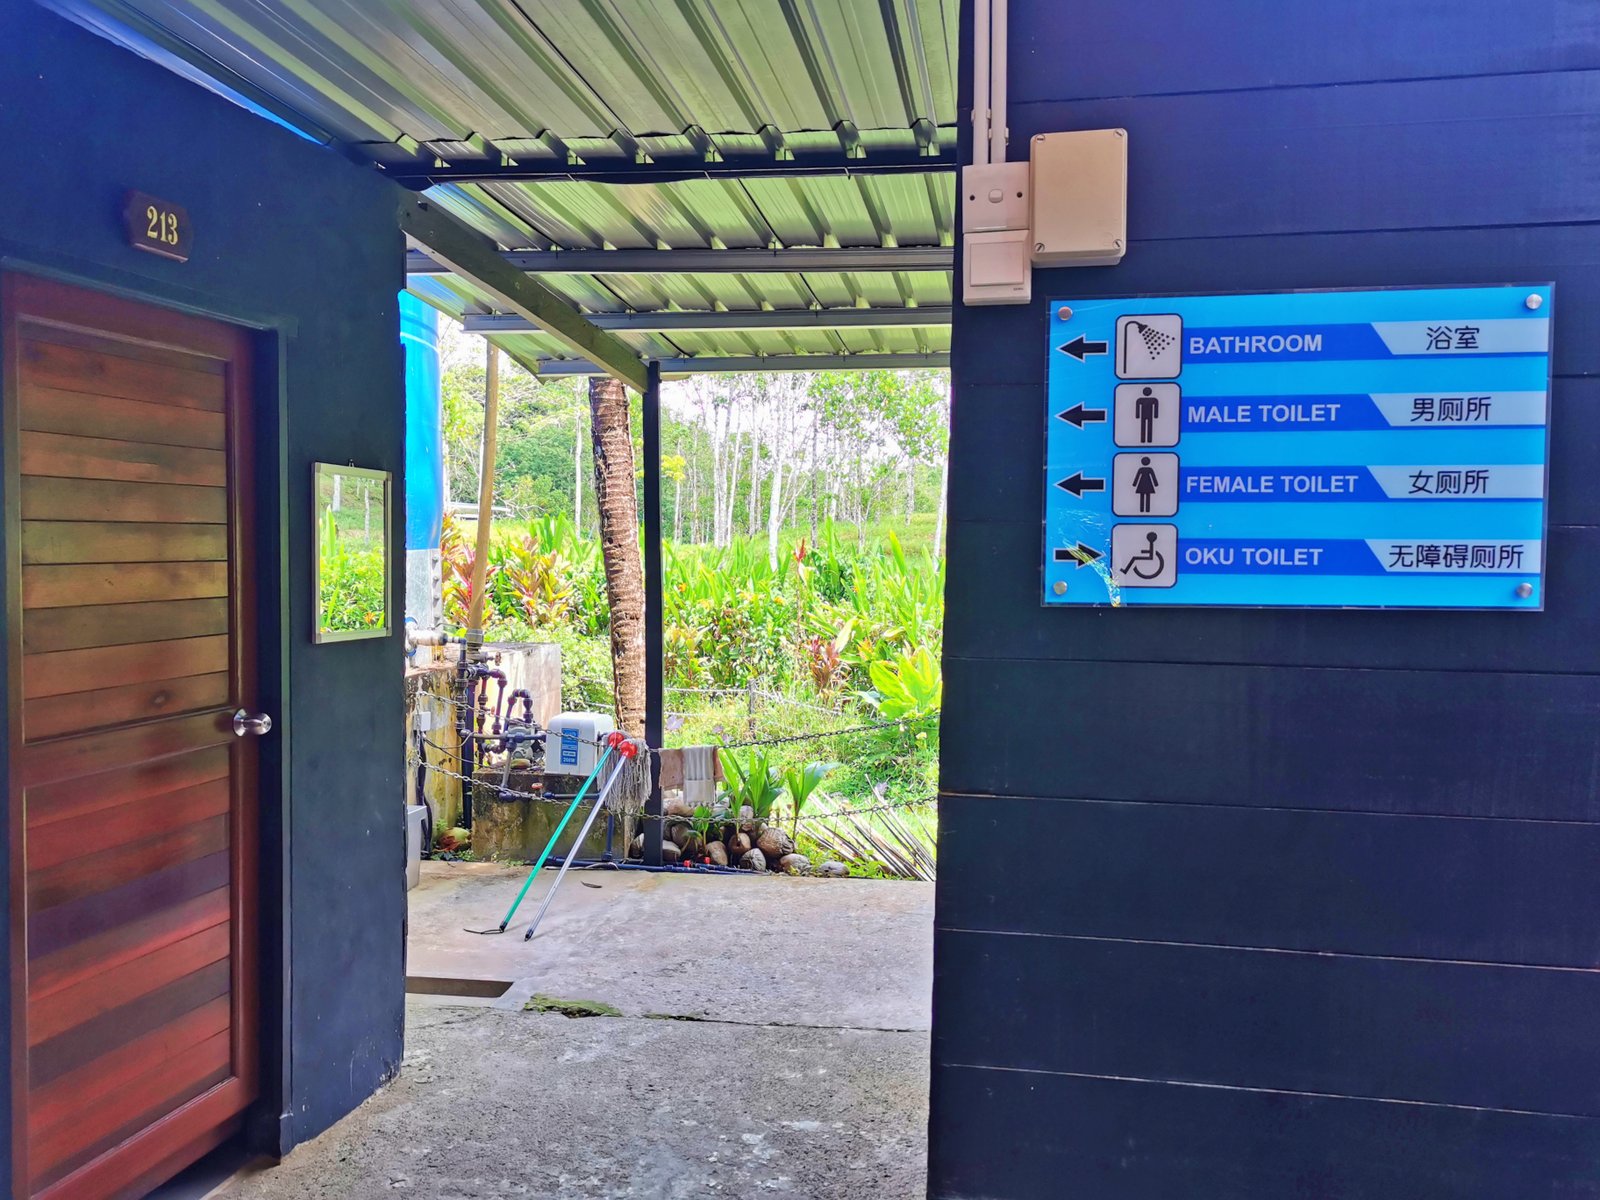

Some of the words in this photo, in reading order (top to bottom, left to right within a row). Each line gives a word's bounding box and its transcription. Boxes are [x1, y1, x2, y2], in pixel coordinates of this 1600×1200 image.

[147, 205, 178, 245] 213
[1189, 334, 1322, 354] BATHROOM
[1426, 325, 1480, 351] 浴室
[1187, 405, 1252, 423] MALE
[1258, 404, 1341, 422] TOILET
[1410, 396, 1491, 422] 男厕所
[1186, 475, 1274, 493] FEMALE
[1280, 475, 1359, 493] TOILET
[1408, 469, 1489, 494] 女厕所
[1185, 547, 1234, 565] OKU
[1241, 548, 1323, 565] TOILET
[1389, 544, 1524, 569] 无障碍厕所
